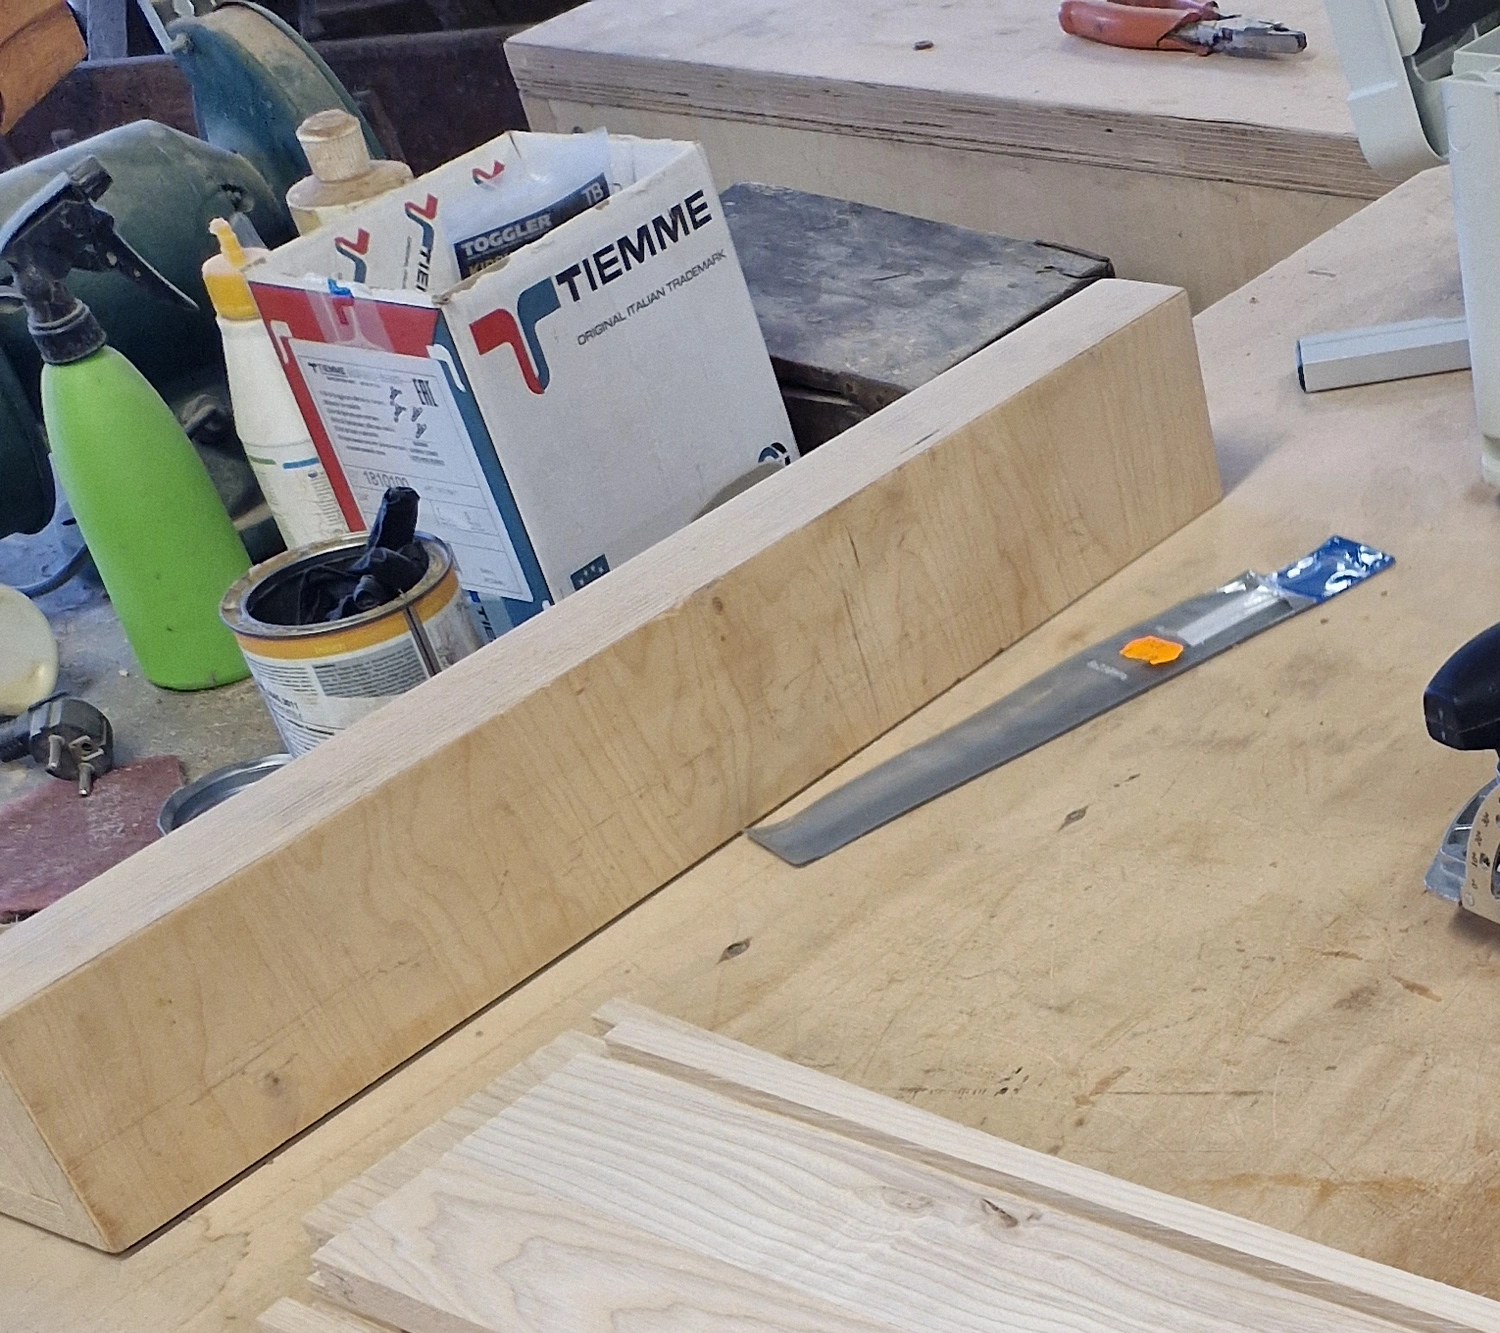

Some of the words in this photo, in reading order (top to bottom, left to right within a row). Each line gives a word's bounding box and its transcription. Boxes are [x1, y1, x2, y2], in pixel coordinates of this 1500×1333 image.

[416, 247, 431, 292] TIE
[461, 213, 553, 256] TOGGLER
[556, 189, 713, 303] TIEMME
[577, 312, 626, 346] ORIGINAL
[627, 290, 666, 316] ITALIAN
[666, 249, 727, 296] TRADEMARK
